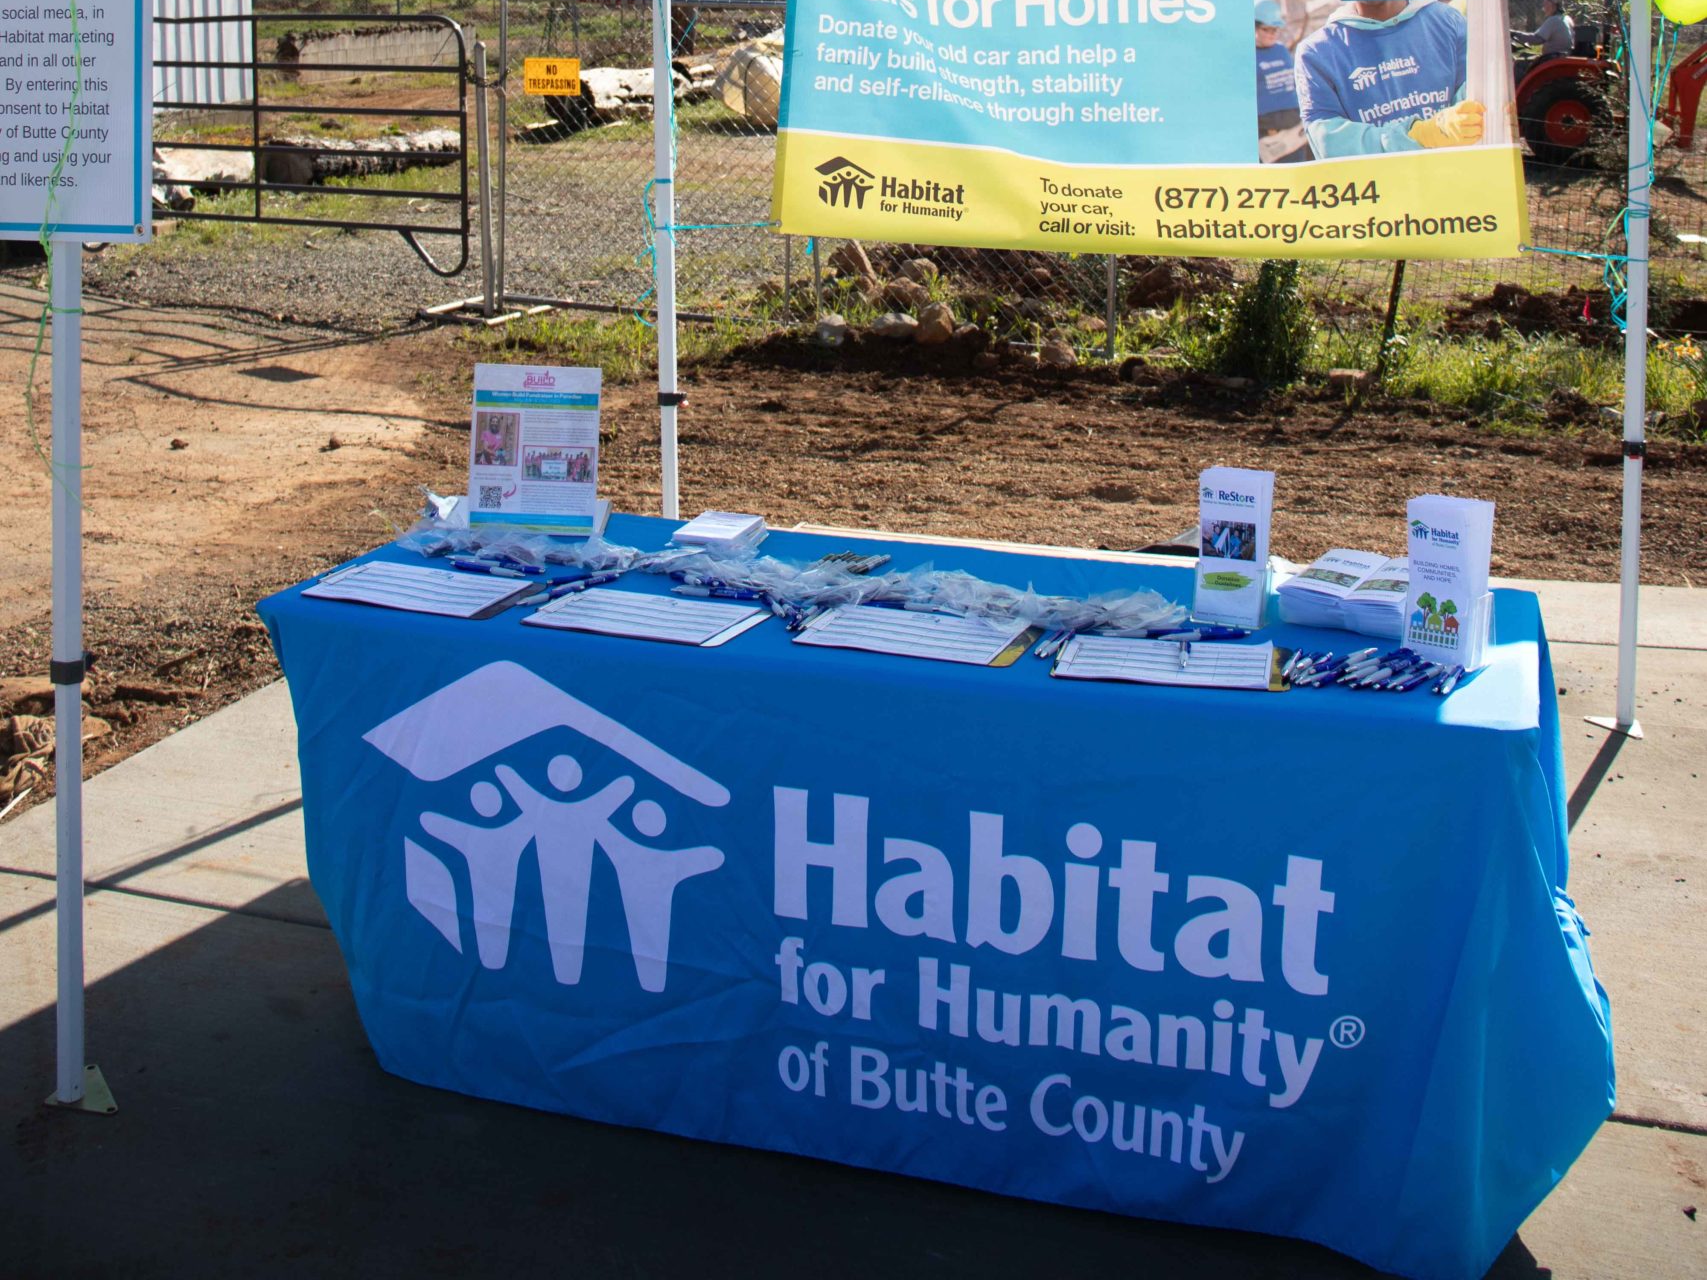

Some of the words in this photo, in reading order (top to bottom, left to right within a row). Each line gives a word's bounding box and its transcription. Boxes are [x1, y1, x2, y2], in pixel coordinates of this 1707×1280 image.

[1, 6, 39, 20] social
[43, 6, 88, 20] meda,
[93, 5, 104, 19] in
[0, 30, 44, 43] Habitat
[818, 14, 898, 40] Donate
[903, 27, 935, 53] your
[938, 44, 968, 64] old
[973, 49, 1010, 65] car
[1017, 44, 1060, 65] and
[1067, 43, 1117, 67] help
[1123, 47, 1136, 63] a
[0, 54, 23, 67] and
[27, 54, 39, 67] in
[43, 54, 58, 67] all
[62, 55, 97, 67] other
[1378, 56, 1416, 73] Habitat
[546, 65, 557, 75] NO
[816, 42, 881, 71] family
[887, 48, 936, 73] build
[938, 66, 1026, 97] strength,
[1032, 72, 1123, 97] stability
[5, 78, 22, 94] By
[26, 78, 80, 94] entering
[84, 78, 108, 91] this
[529, 79, 576, 90] TRESPASSING
[814, 74, 854, 93] and
[859, 77, 985, 113] self-reliance
[986, 102, 1074, 126] through
[1080, 101, 1165, 123] shelter.
[1358, 86, 1449, 123] International
[45, 102, 58, 115] to
[62, 102, 110, 116] Habitat
[6, 125, 19, 139] of
[23, 126, 57, 139] Butte
[61, 126, 109, 143] County
[14, 150, 38, 163] and
[42, 149, 78, 166] using
[82, 152, 112, 166] your
[881, 175, 964, 204] Habitat
[1039, 177, 1058, 195] To
[1061, 182, 1123, 199] donate
[1154, 186, 1229, 212] (877)
[1237, 181, 1380, 209] 277-4344
[881, 200, 898, 213] for
[903, 202, 963, 221] Humanity
[1040, 200, 1077, 215] your
[1082, 203, 1113, 217] car,
[1039, 218, 1070, 233] call
[1073, 221, 1091, 234] or
[1097, 220, 1136, 236] visit:
[1156, 214, 1498, 244] habitat.org/carsforhomes
[527, 375, 555, 385] BUILD
[1219, 490, 1255, 503] ReStore
[1431, 528, 1459, 540] Habitat
[1413, 560, 1438, 568] BUILDING
[773, 785, 1335, 995] Habitat
[775, 936, 884, 1023] for
[779, 1040, 831, 1098] of
[850, 1046, 1008, 1131] Butte
[1030, 1073, 1245, 1183] County
